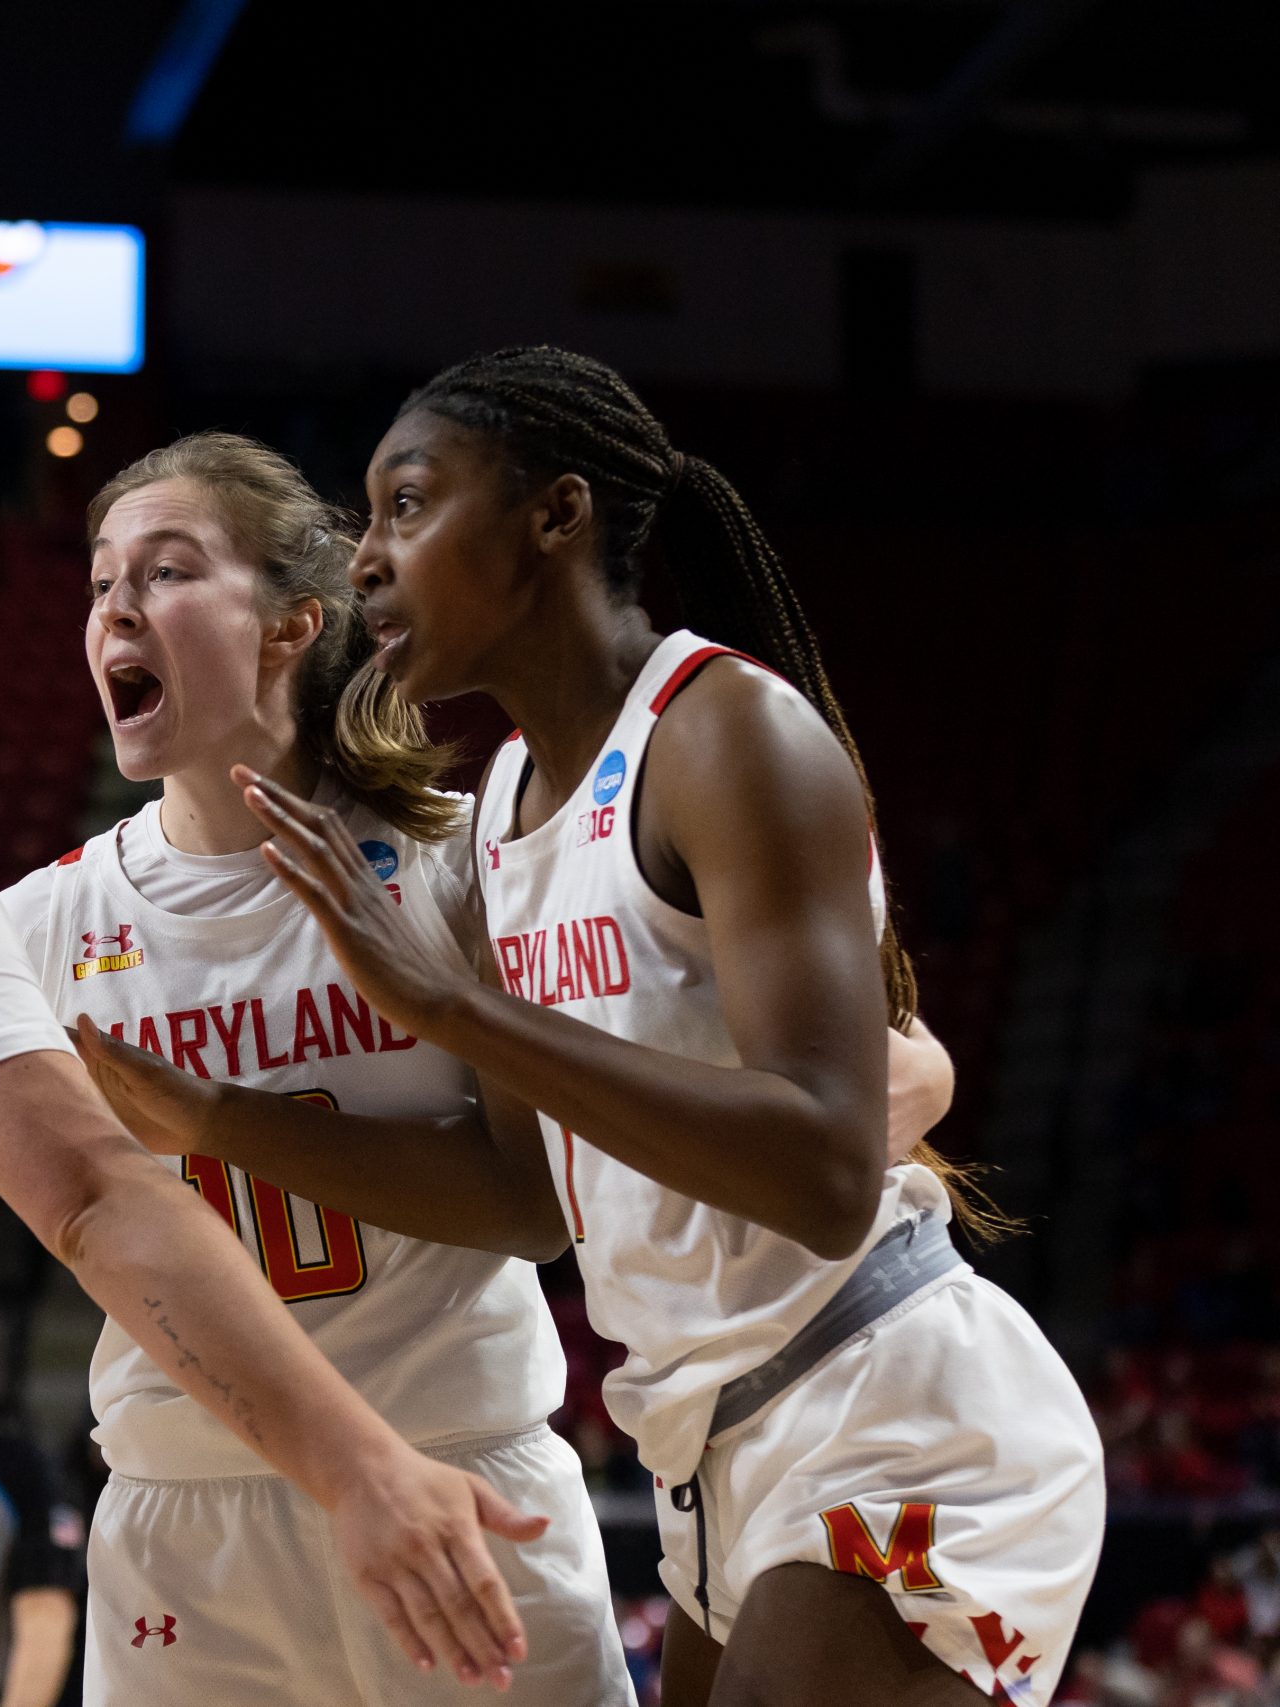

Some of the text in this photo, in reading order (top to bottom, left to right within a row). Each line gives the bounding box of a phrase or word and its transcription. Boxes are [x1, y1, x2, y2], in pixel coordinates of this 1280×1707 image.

[74, 949, 144, 980] GRADUATE
[492, 915, 631, 1006] RYLAND
[110, 983, 418, 1080] ARYLAN
[818, 1502, 945, 1592] M
